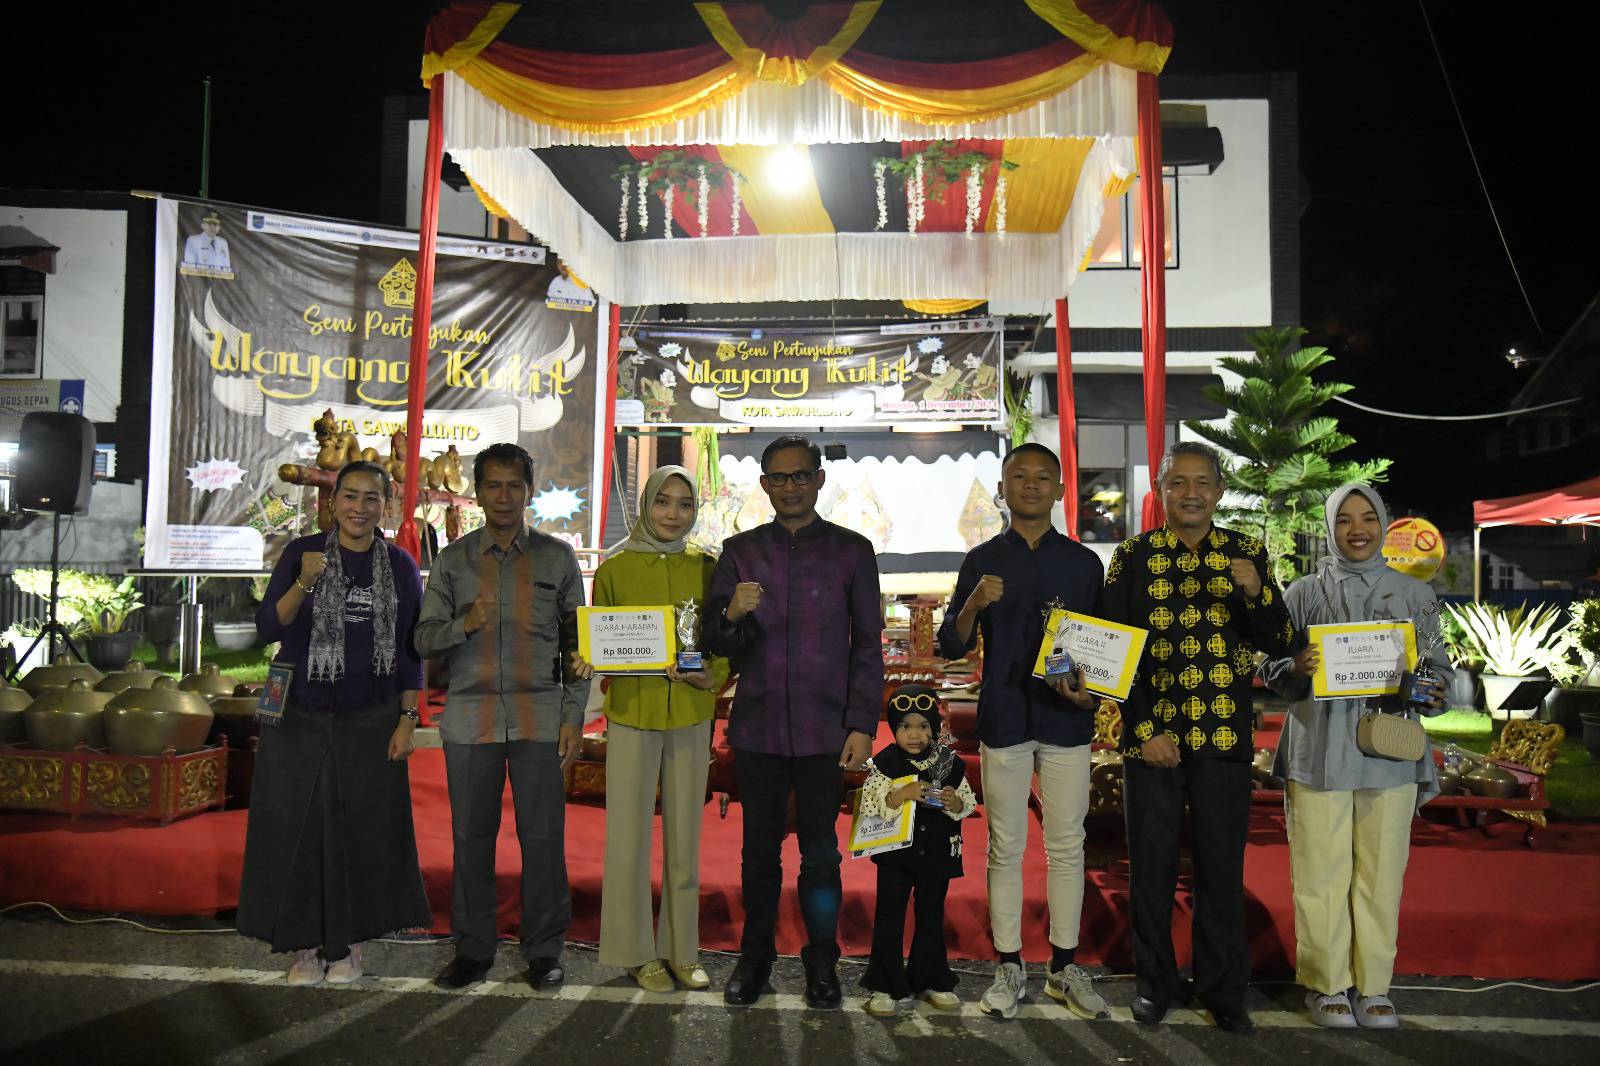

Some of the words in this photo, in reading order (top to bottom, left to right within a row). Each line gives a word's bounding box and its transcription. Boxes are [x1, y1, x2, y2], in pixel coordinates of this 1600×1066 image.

[303, 304, 358, 336] Seni
[364, 310, 491, 349] Pertjukan
[737, 340, 769, 360] Seni
[773, 340, 855, 362] Pertunjukan
[441, 349, 573, 395] Kulit
[687, 358, 810, 399] Wayang
[823, 355, 912, 385] Kulit
[0, 395, 23, 406] UGUS
[24, 395, 49, 406] DEPAN
[741, 405, 773, 418] KOTA
[363, 418, 480, 441] SAWALUNTO
[594, 624, 619, 632] JUARA
[621, 623, 658, 631] HARAPAN
[1075, 634, 1099, 648] JUARA
[603, 648, 615, 657] Rp
[617, 647, 657, 656] 800.000,-
[1348, 645, 1374, 654] JUARA
[1335, 673, 1347, 682] Rp
[1349, 670, 1401, 681] 2.000.000,-
